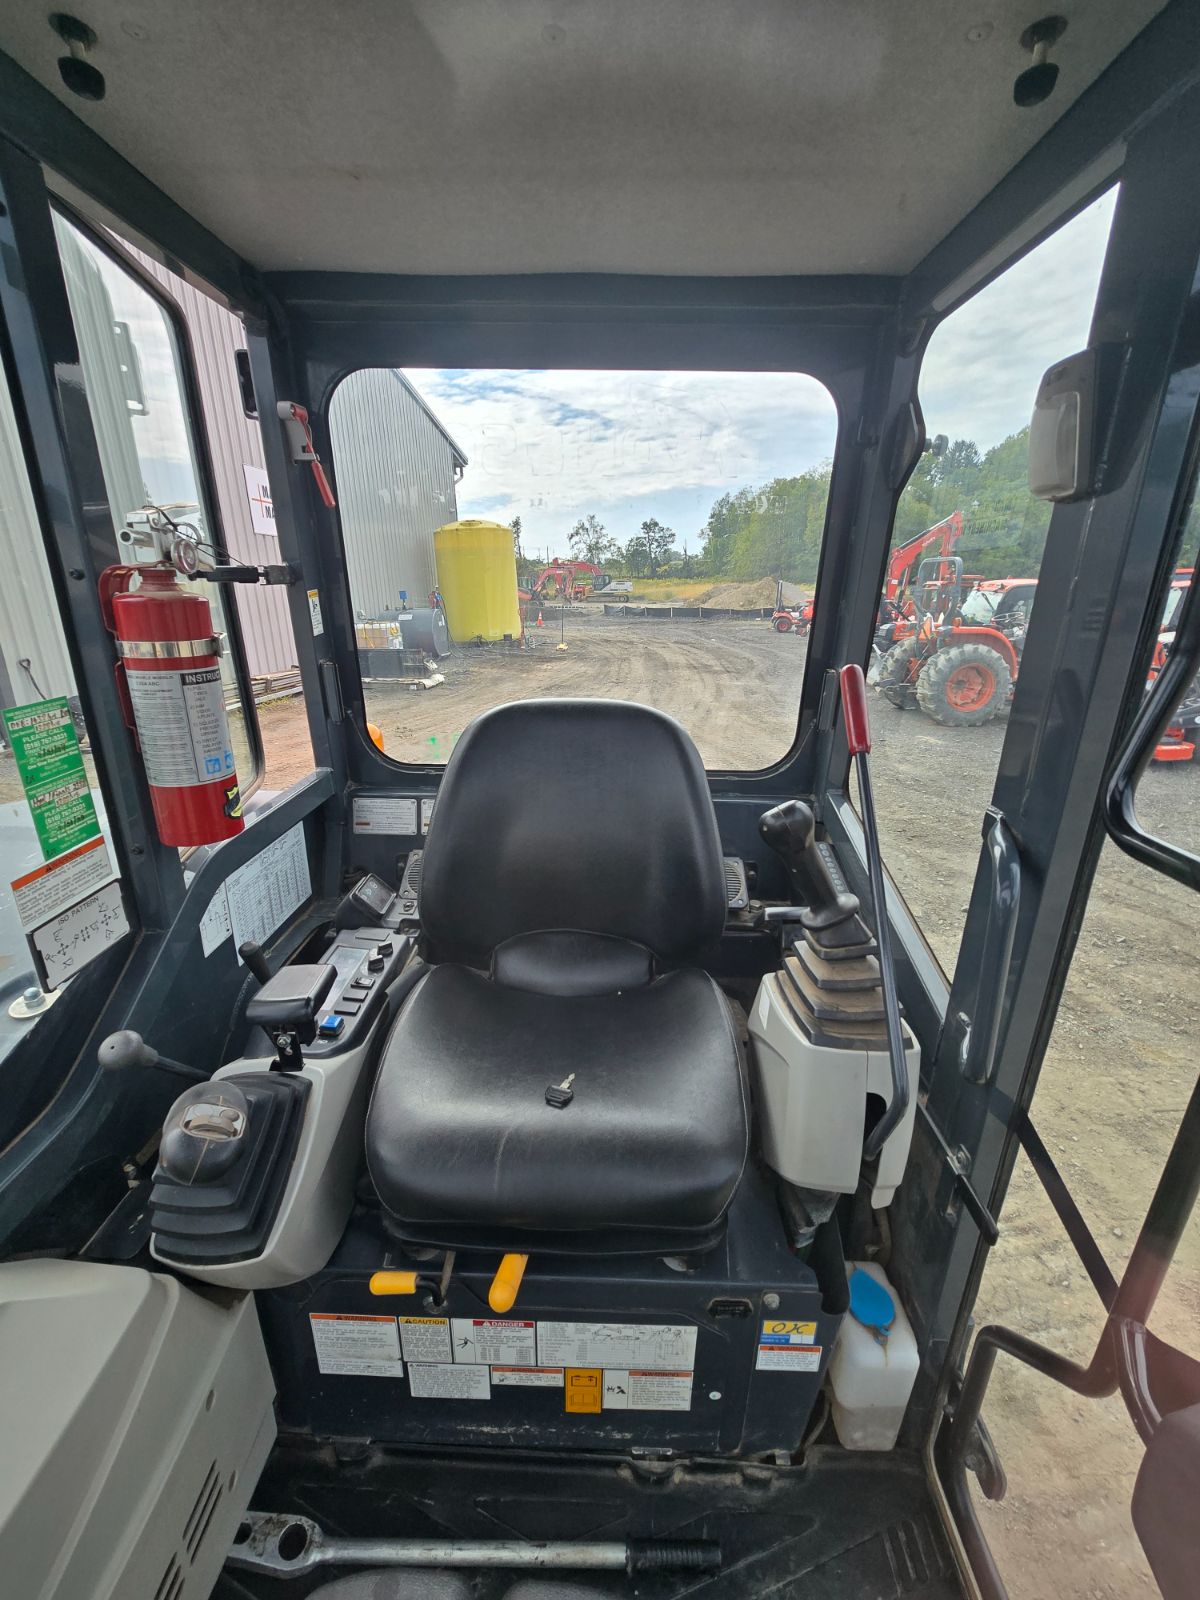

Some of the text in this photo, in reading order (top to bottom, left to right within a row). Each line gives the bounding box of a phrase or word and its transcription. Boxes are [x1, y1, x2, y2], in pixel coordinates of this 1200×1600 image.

[22, 731, 49, 743] PLEASE
[48, 727, 65, 736] CALL
[44, 804, 69, 818] PLEASE
[68, 798, 84, 807] CALL
[58, 895, 100, 926] ISO PATTERN
